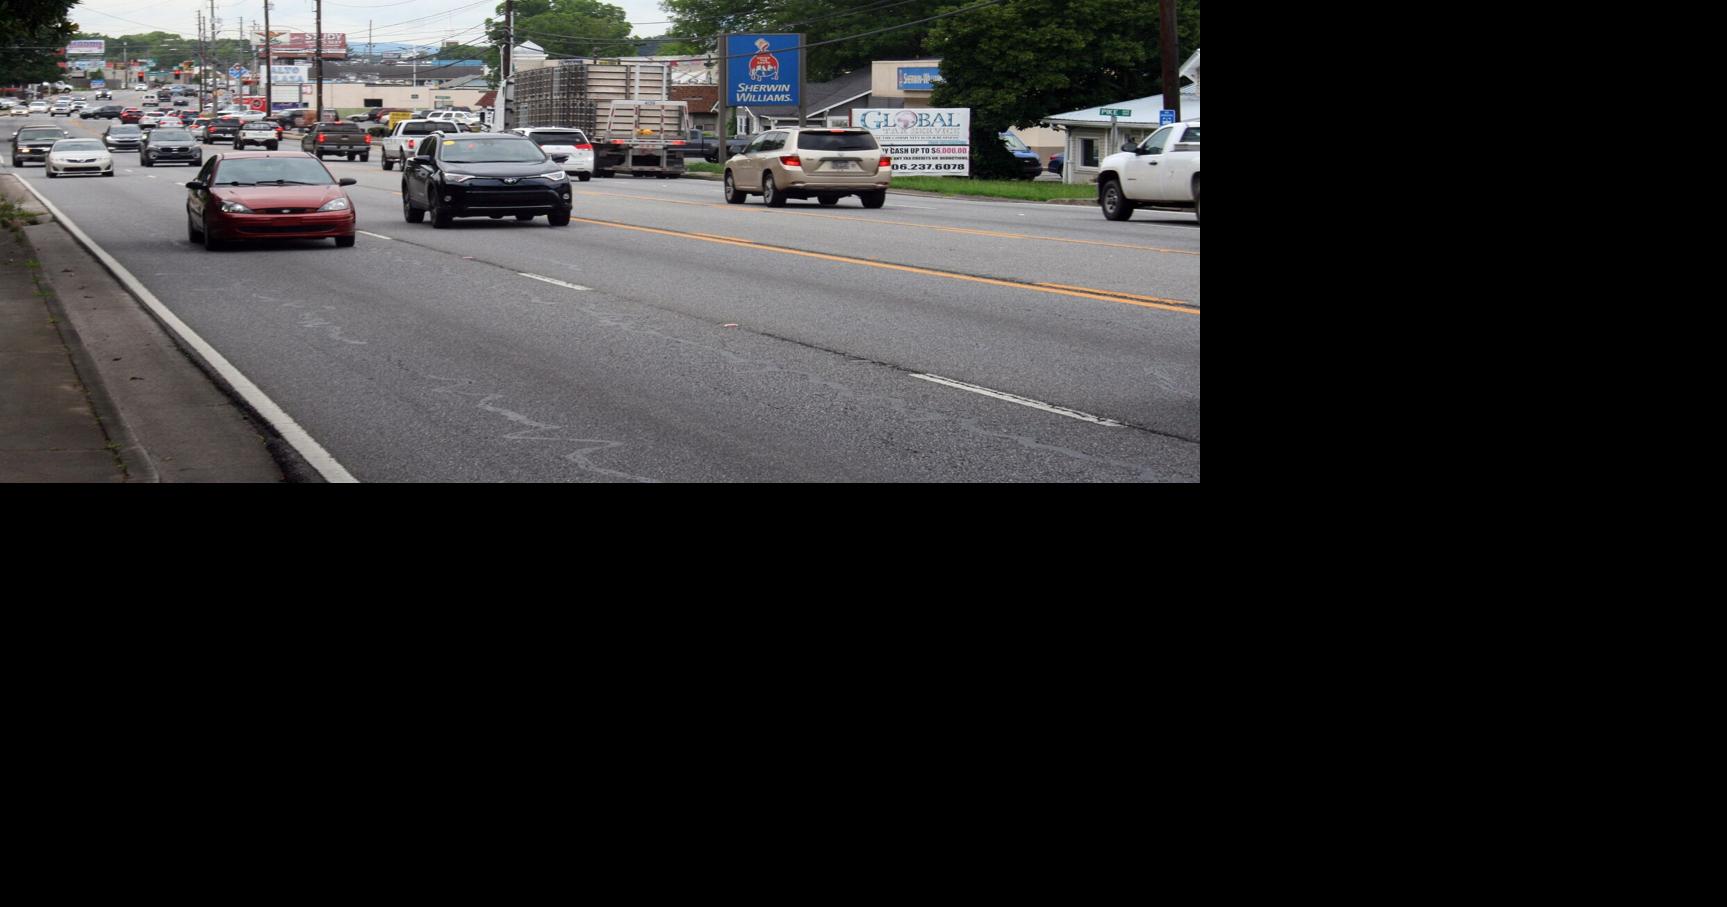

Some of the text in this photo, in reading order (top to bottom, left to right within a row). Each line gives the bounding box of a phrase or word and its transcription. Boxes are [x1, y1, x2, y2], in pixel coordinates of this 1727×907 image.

[737, 82, 791, 93] SHERWIN
[736, 93, 793, 102] WILLIAMS
[860, 110, 961, 130] GLOBAL
